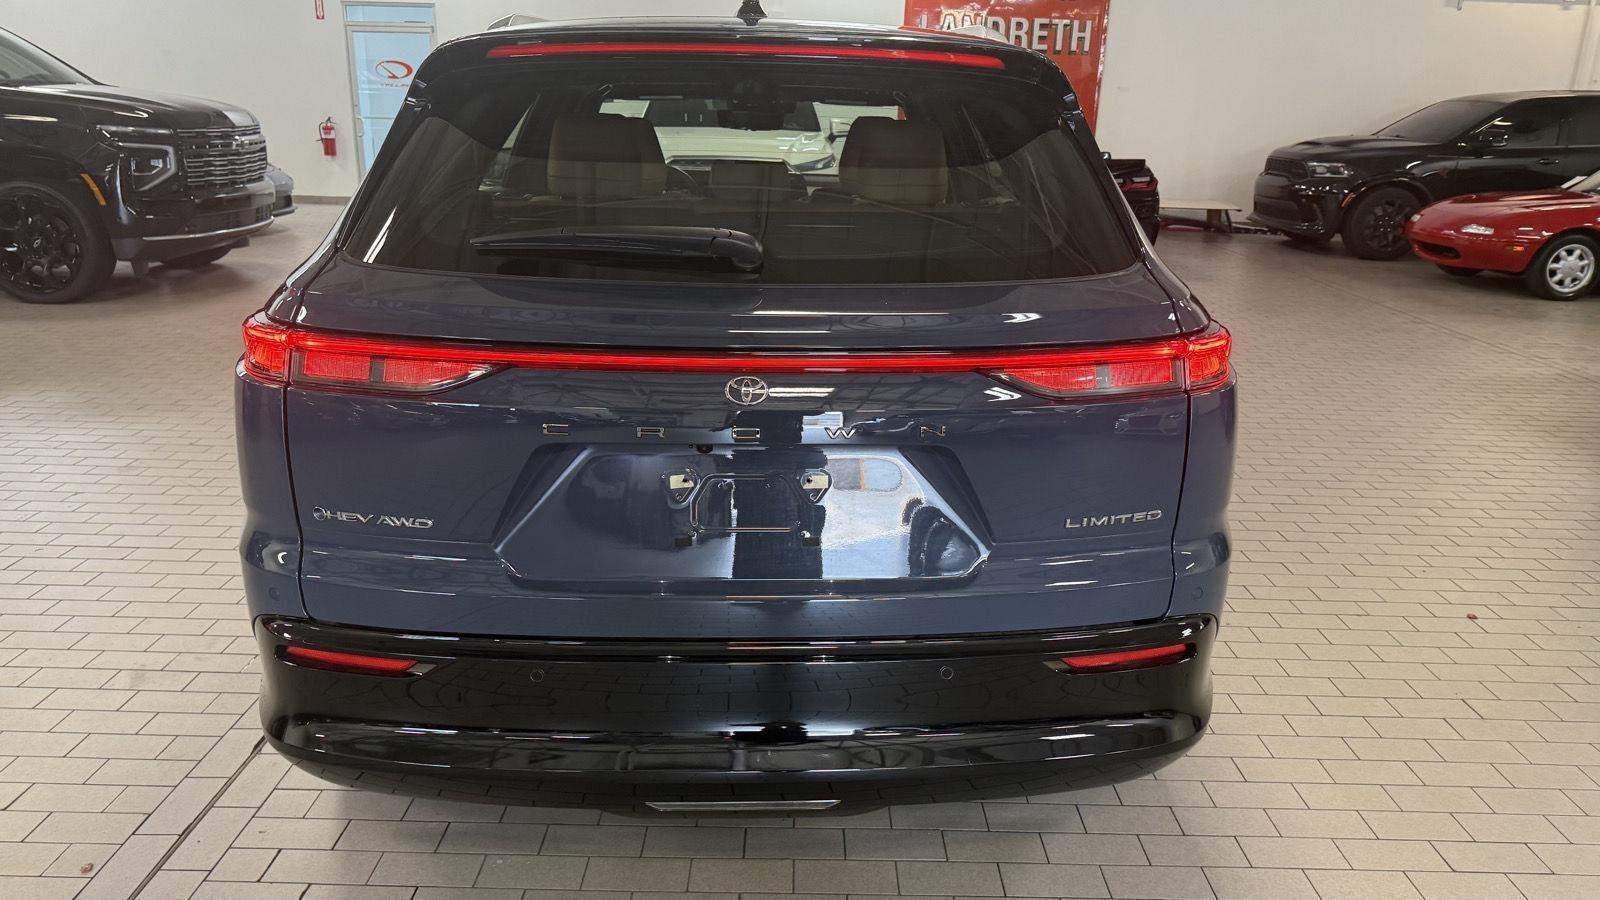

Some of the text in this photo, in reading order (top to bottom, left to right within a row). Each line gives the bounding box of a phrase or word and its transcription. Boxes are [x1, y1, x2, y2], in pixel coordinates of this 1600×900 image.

[542, 423, 946, 440] CROWN
[376, 515, 434, 529] AWD
[1065, 509, 1162, 528] LIMITED
